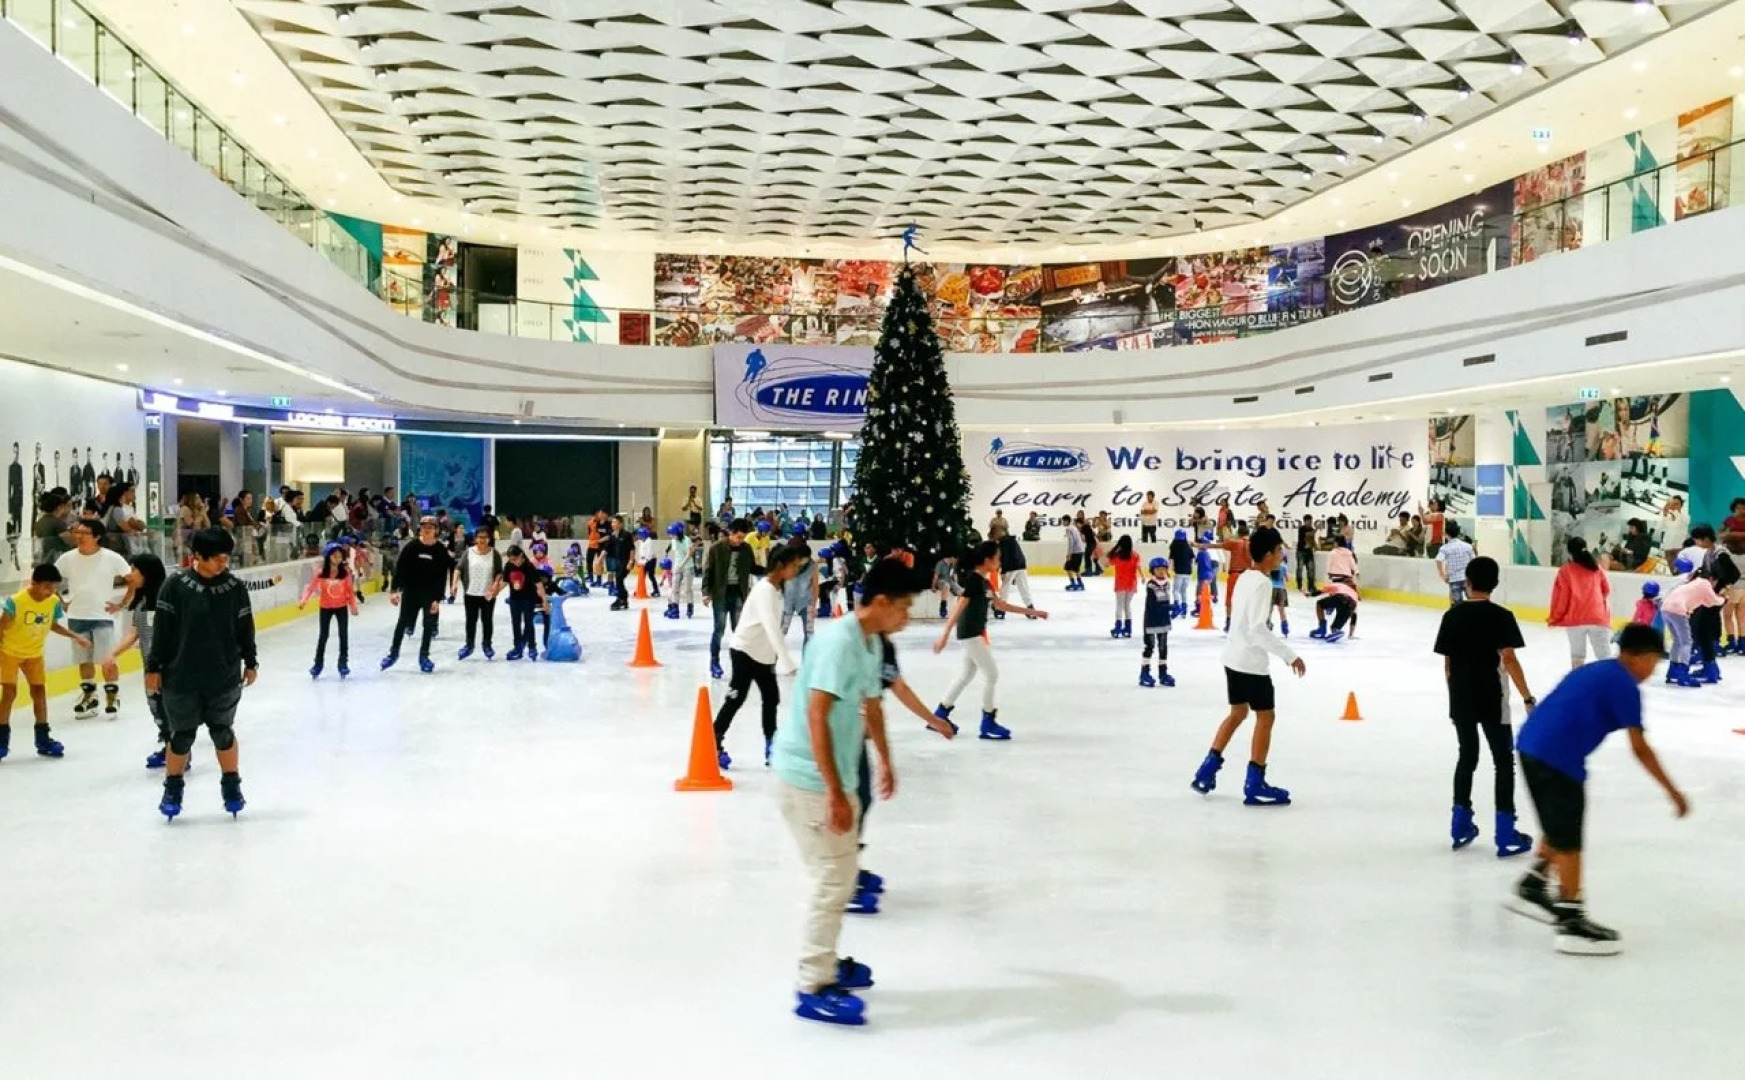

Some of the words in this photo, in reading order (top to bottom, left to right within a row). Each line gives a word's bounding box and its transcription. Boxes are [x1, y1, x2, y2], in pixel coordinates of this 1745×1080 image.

[1407, 210, 1484, 256] OPENING
[1418, 243, 1468, 281] SOON
[772, 388, 815, 405] THE
[825, 388, 868, 406] RIN
[1005, 456, 1029, 466] THE
[1036, 456, 1071, 466] RINK
[1106, 446, 1161, 470] We
[1176, 447, 1266, 477] bring
[1277, 448, 1321, 470] ice
[1333, 452, 1361, 470] to
[990, 480, 1093, 507] Learn
[1112, 485, 1144, 506] to
[1161, 479, 1268, 507] Skate
[1282, 477, 1411, 519] Academy
[181, 575, 204, 592] NEW
[210, 579, 237, 594] YORK
